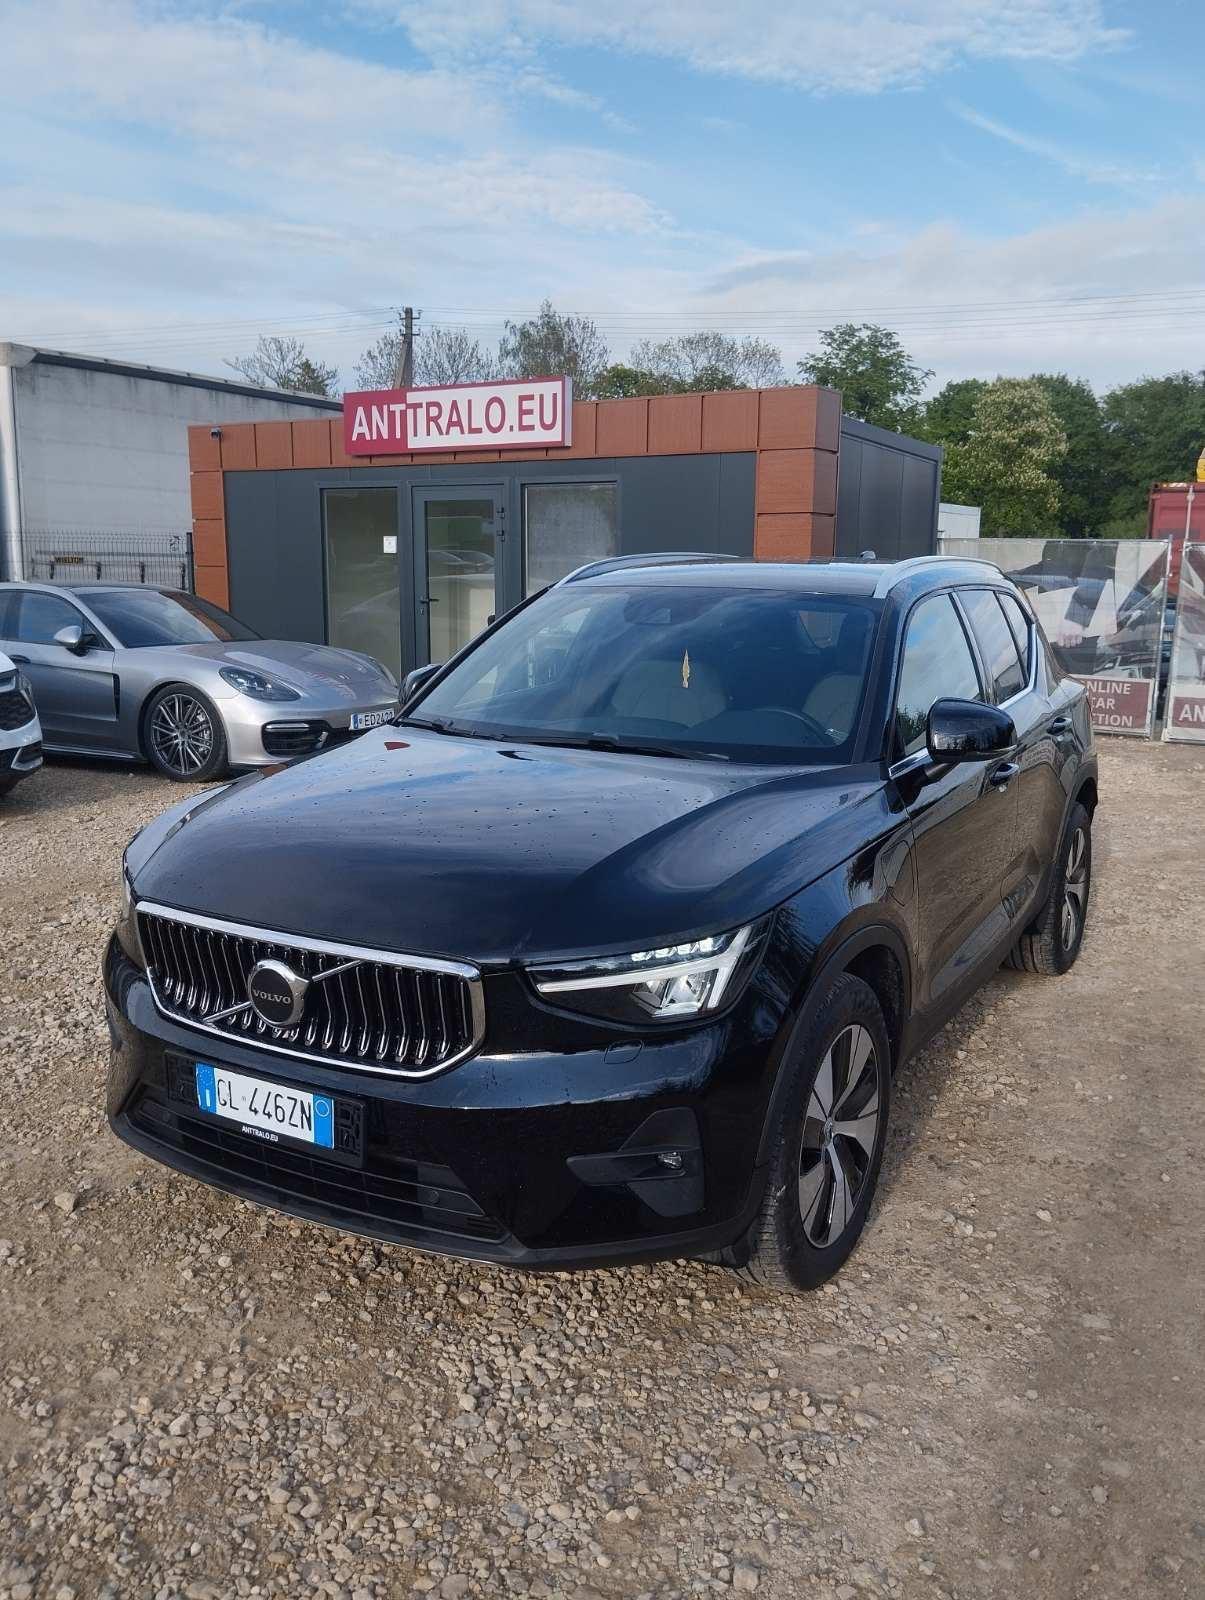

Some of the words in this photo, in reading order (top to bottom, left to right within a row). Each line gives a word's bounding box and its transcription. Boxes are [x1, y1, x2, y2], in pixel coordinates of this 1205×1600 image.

[351, 392, 558, 441] ANTTRALO.EU
[1081, 681, 1132, 695] NLINE
[252, 989, 292, 1005] VOLVO
[249, 1087, 312, 1132] 446ZN
